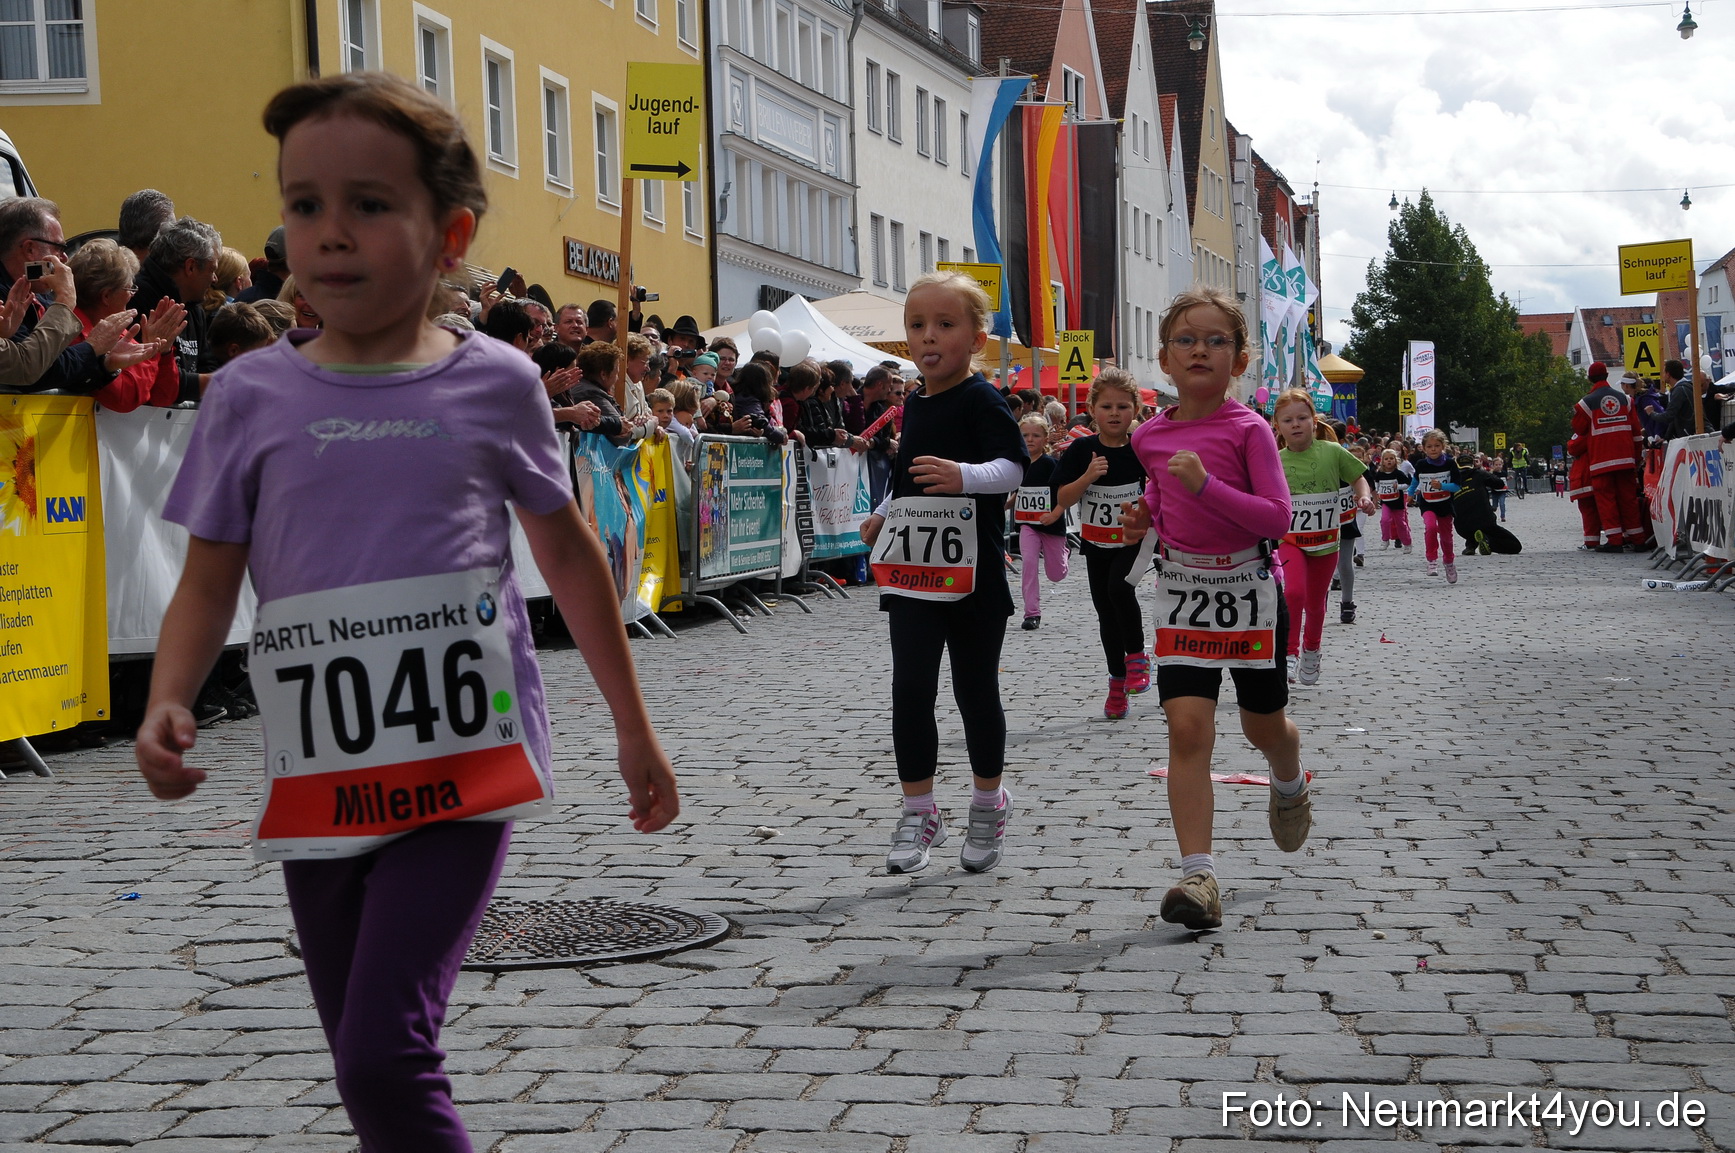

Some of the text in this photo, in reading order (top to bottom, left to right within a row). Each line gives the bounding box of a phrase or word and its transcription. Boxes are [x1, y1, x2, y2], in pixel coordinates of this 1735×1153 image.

[629, 93, 700, 117] Jugend-
[647, 116, 680, 135] lauf
[1623, 256, 1687, 270] Schnupper-
[1645, 270, 1666, 281] lauf
[1062, 332, 1090, 342] Block
[1627, 327, 1659, 338] Block
[1065, 346, 1086, 372] A
[1633, 341, 1656, 369] A
[1403, 398, 1412, 410] B
[1497, 438, 1503, 446] C
[730, 490, 766, 511] Mehr Sicherheit
[1017, 496, 1045, 510] 7049
[1103, 490, 1136, 500] Neumarkt
[887, 507, 955, 521] PARTL Neumarkt
[1290, 507, 1335, 531] 7217
[880, 525, 964, 565] 7176
[889, 569, 945, 590] Sophie
[1158, 570, 1254, 585] PARTL Neumarkt
[1167, 588, 1259, 629] 7281
[253, 603, 468, 656] PARTL Neumarkt
[0, 640, 23, 657] ufen
[1174, 633, 1250, 656] Hermine
[0, 663, 69, 685] artenmauern
[275, 639, 489, 759] 7046
[498, 721, 513, 740] W
[332, 780, 463, 827] Milena
